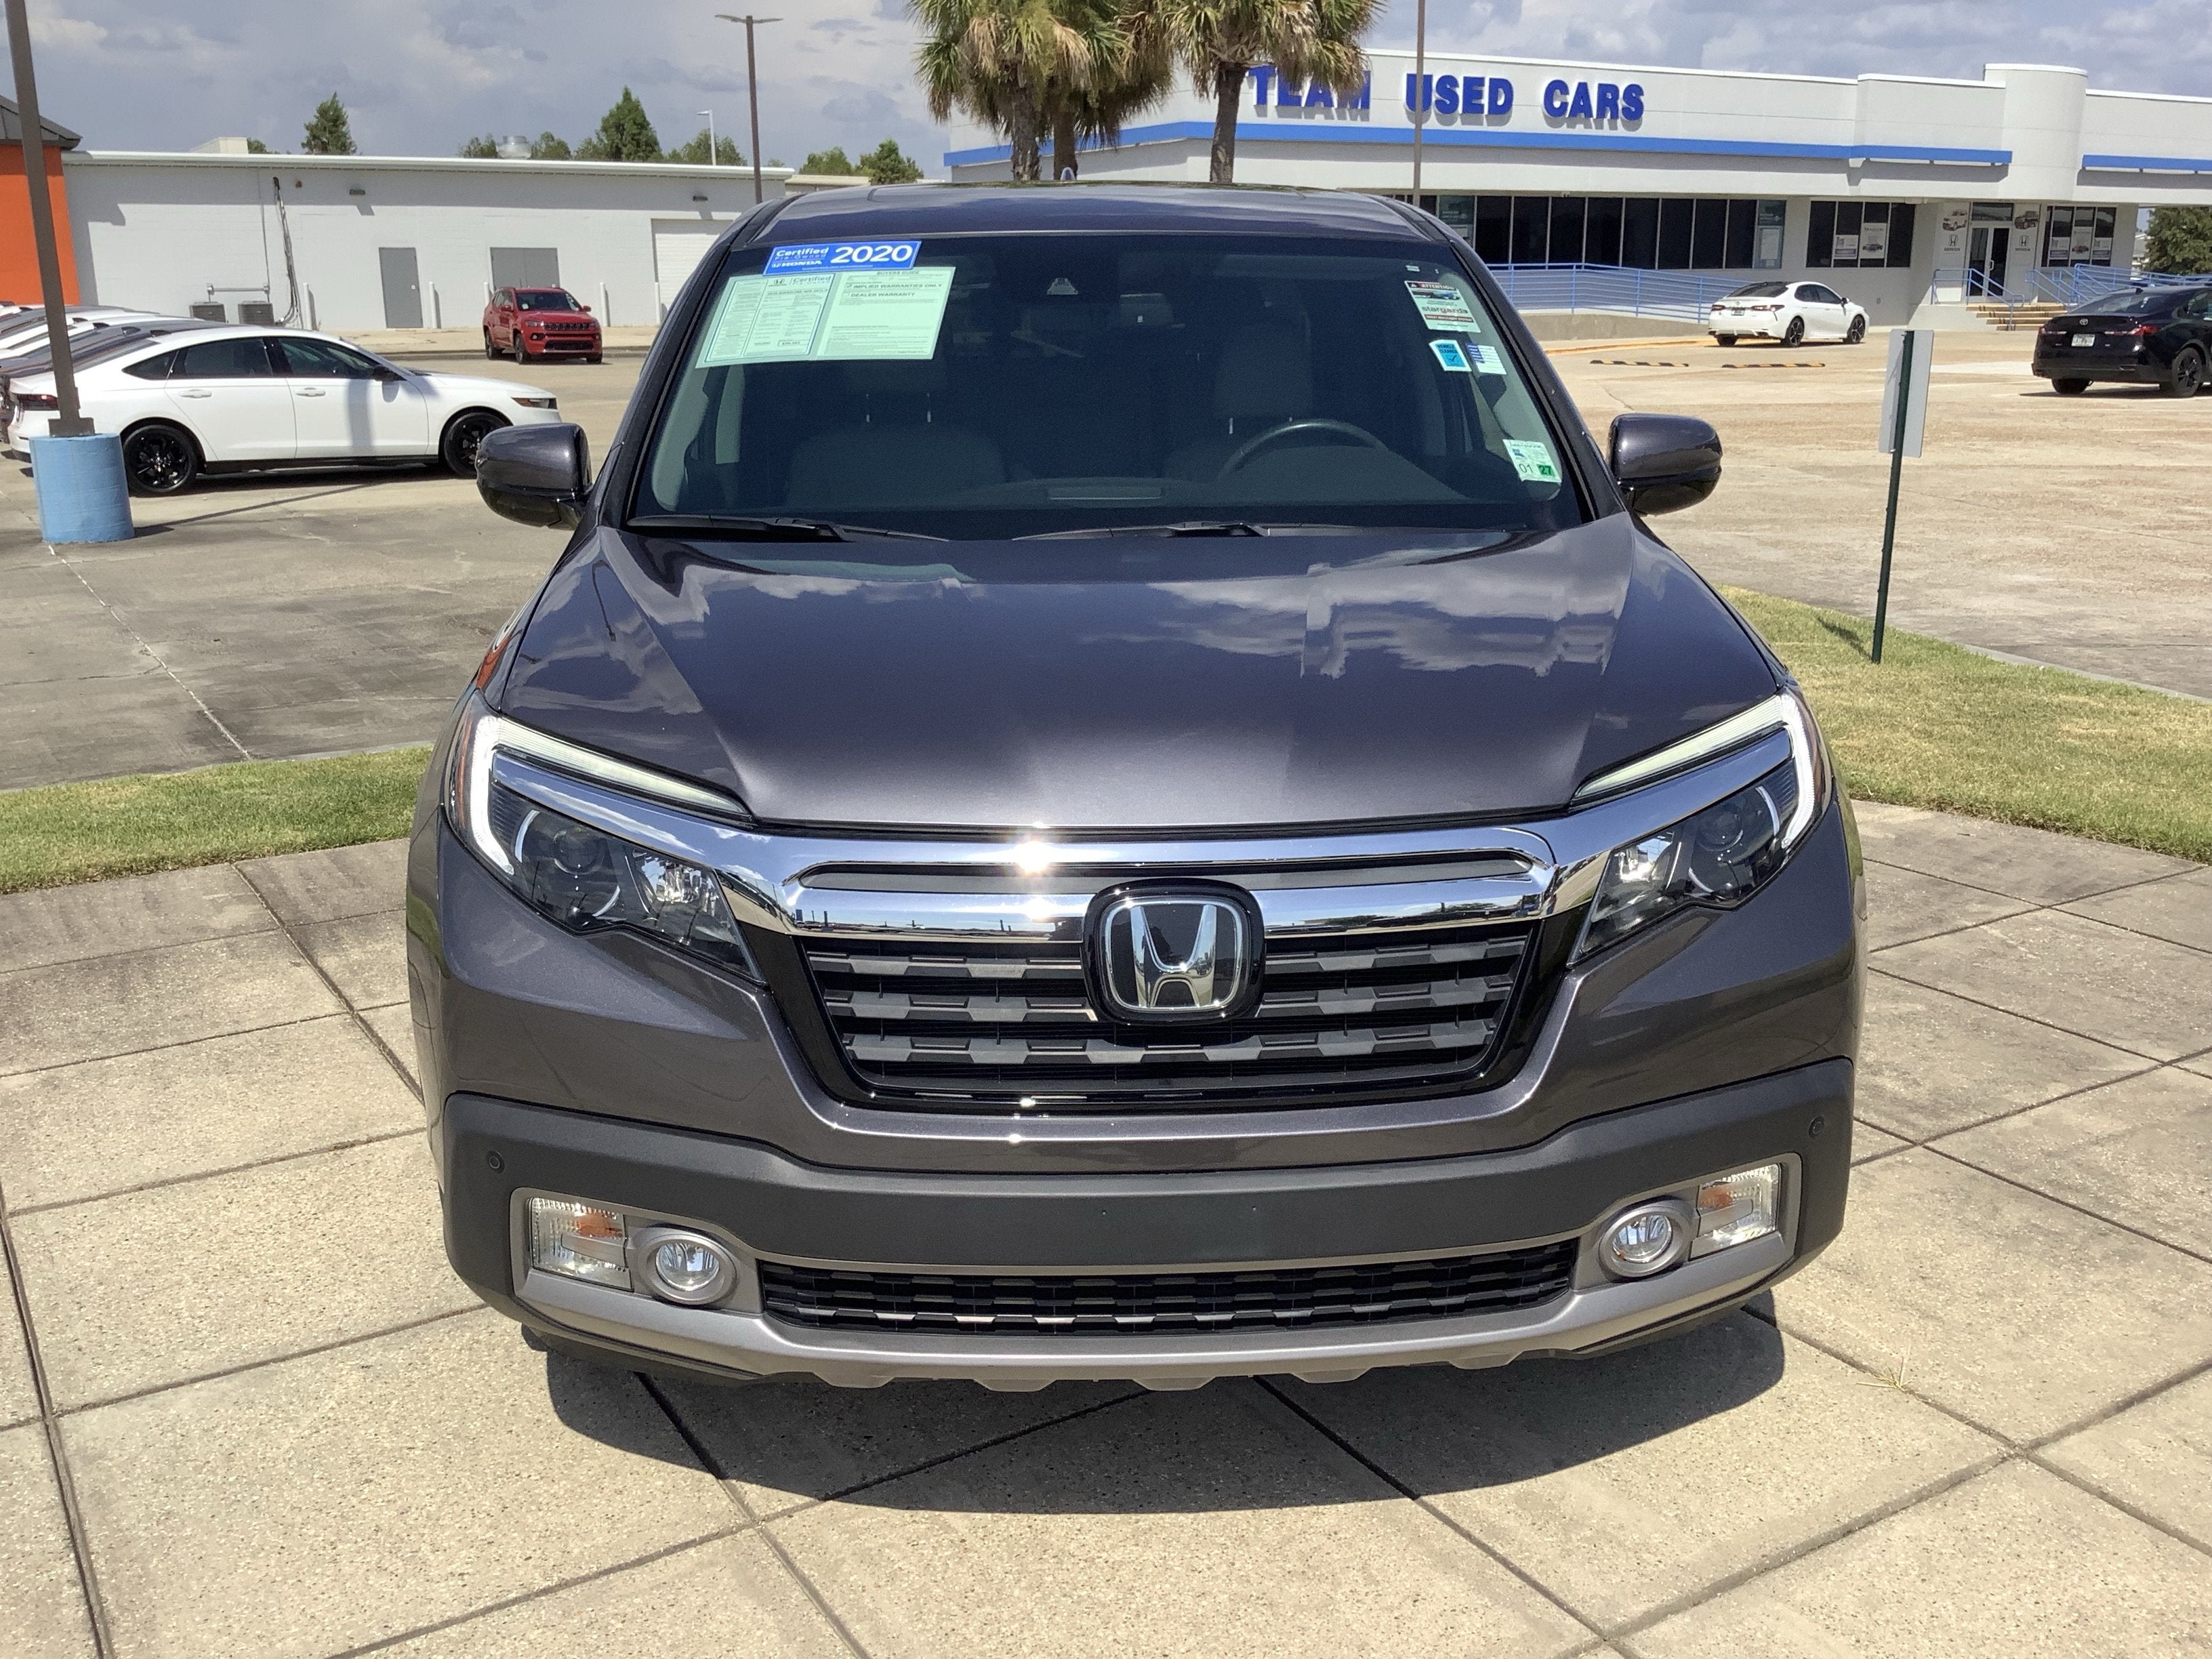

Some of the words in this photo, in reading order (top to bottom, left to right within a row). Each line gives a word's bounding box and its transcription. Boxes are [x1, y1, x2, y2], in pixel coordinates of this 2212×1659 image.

[1406, 73, 1513, 116] USED
[1543, 79, 1645, 121] CARS
[776, 247, 829, 258] Certified
[830, 245, 913, 264] 2020
[1519, 463, 1534, 473] 01
[1538, 465, 1551, 474] 27
